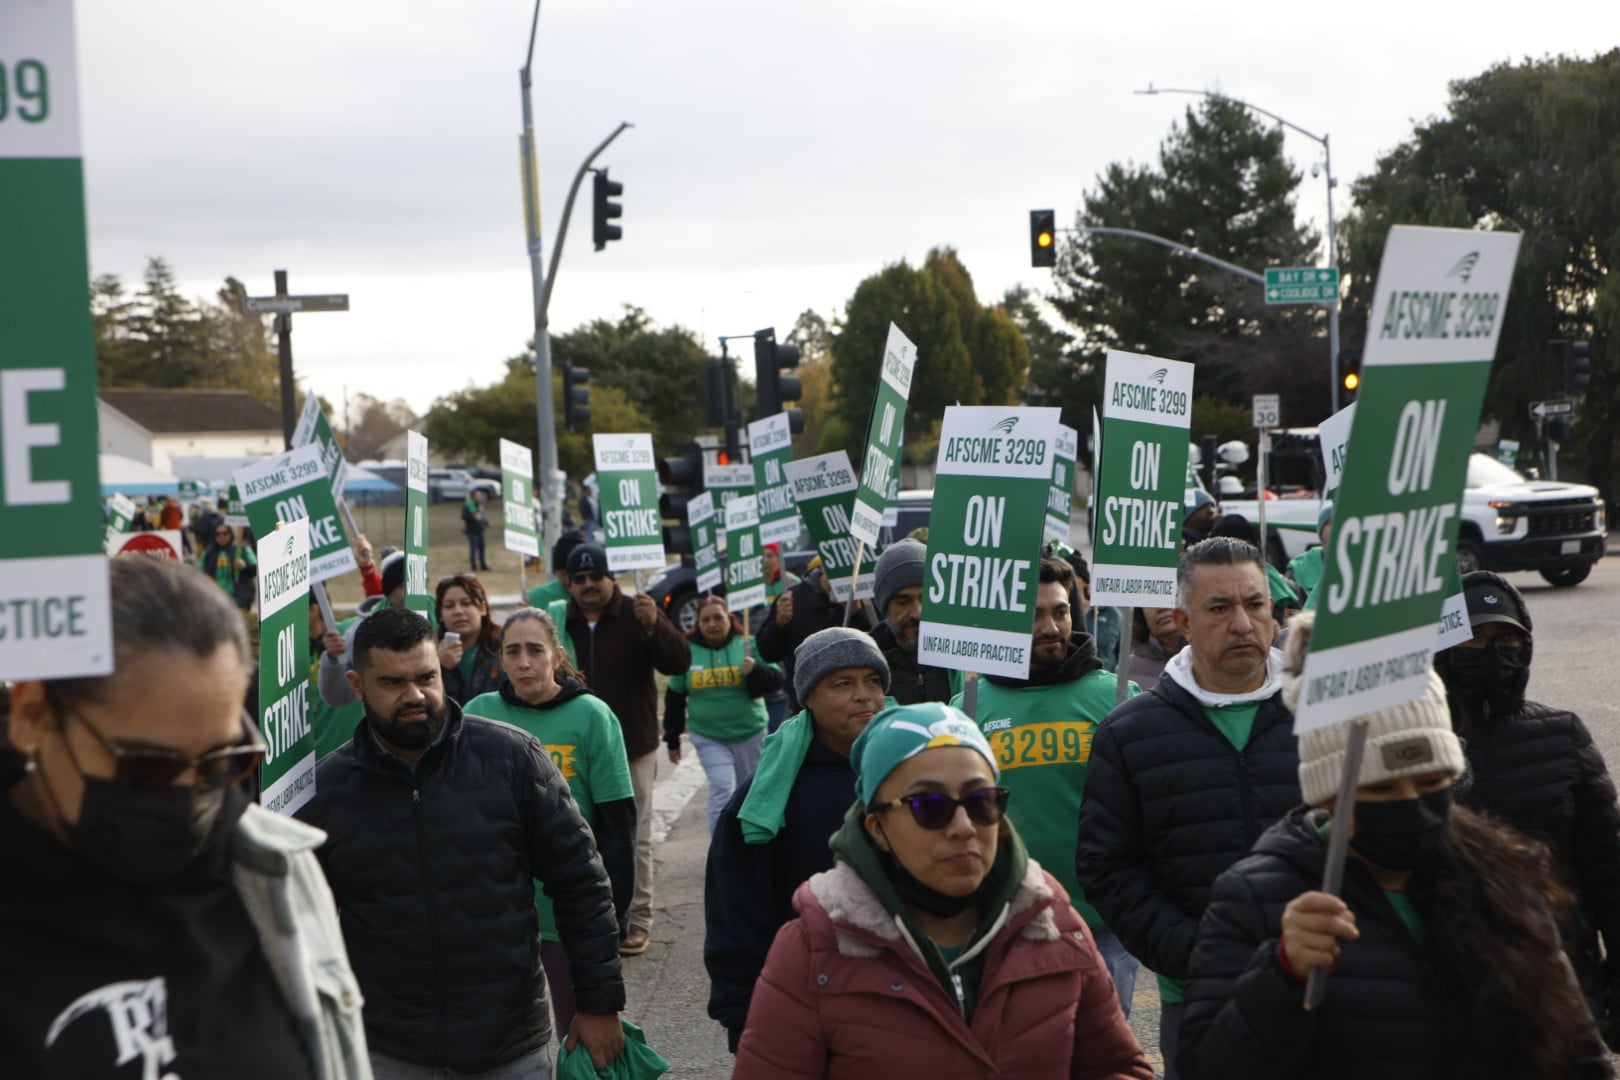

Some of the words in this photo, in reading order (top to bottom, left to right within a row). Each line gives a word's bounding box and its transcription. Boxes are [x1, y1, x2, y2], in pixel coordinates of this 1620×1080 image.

[1278, 271, 1299, 283] BAY
[1303, 271, 1316, 282] DR
[1280, 287, 1319, 299] COOLIDGE
[1322, 286, 1335, 297] DR
[1380, 291, 1457, 340] AFSCME
[1455, 291, 1499, 338] 3299
[1112, 381, 1156, 411] AFSCME
[1158, 388, 1187, 416] 3299
[879, 402, 896, 448] ON
[1256, 411, 1277, 424] 30
[945, 437, 1002, 464] AFSCME
[1004, 438, 1046, 466] 3299
[1388, 398, 1447, 496] ON
[244, 471, 288, 497] AFSCME
[288, 459, 319, 481] 3299
[764, 458, 781, 486] ON
[793, 475, 828, 495] AFSCME
[828, 468, 852, 488] 3299
[862, 444, 895, 500] STRIKE
[1054, 462, 1067, 489] ON
[1129, 440, 1161, 492] ON
[618, 478, 642, 507] ON
[758, 484, 795, 517] STRIKE
[504, 501, 536, 531] STRIKE
[605, 508, 660, 539] STRIKE
[821, 503, 851, 535] ON
[963, 494, 1006, 549] ON
[1102, 496, 1179, 550] STRIKE
[739, 533, 755, 558] ON
[1327, 502, 1457, 615] STRIKE
[264, 562, 291, 604] AFSCME
[291, 553, 308, 589] 3299
[406, 553, 428, 596] STRIKE
[729, 554, 764, 587] STRIKE
[928, 551, 1031, 614] STRIKE
[1095, 576, 1122, 594] UNFAIR
[1121, 578, 1143, 595] LABOR
[1143, 579, 1174, 596] PRACTICE
[277, 622, 295, 688] ON
[922, 635, 951, 654] UNFAIR
[951, 639, 979, 659] LABOR
[980, 643, 1024, 665] PRACTICE
[1306, 674, 1347, 707] UNFAIR
[1348, 662, 1382, 695] LABOR
[1383, 648, 1429, 689] PRACTICE
[264, 679, 312, 766] STRIKE
[983, 717, 1013, 733] AFSCME
[999, 727, 1081, 765] 3299
[280, 781, 295, 809] LABOR
[293, 767, 314, 796] PRACTICE
